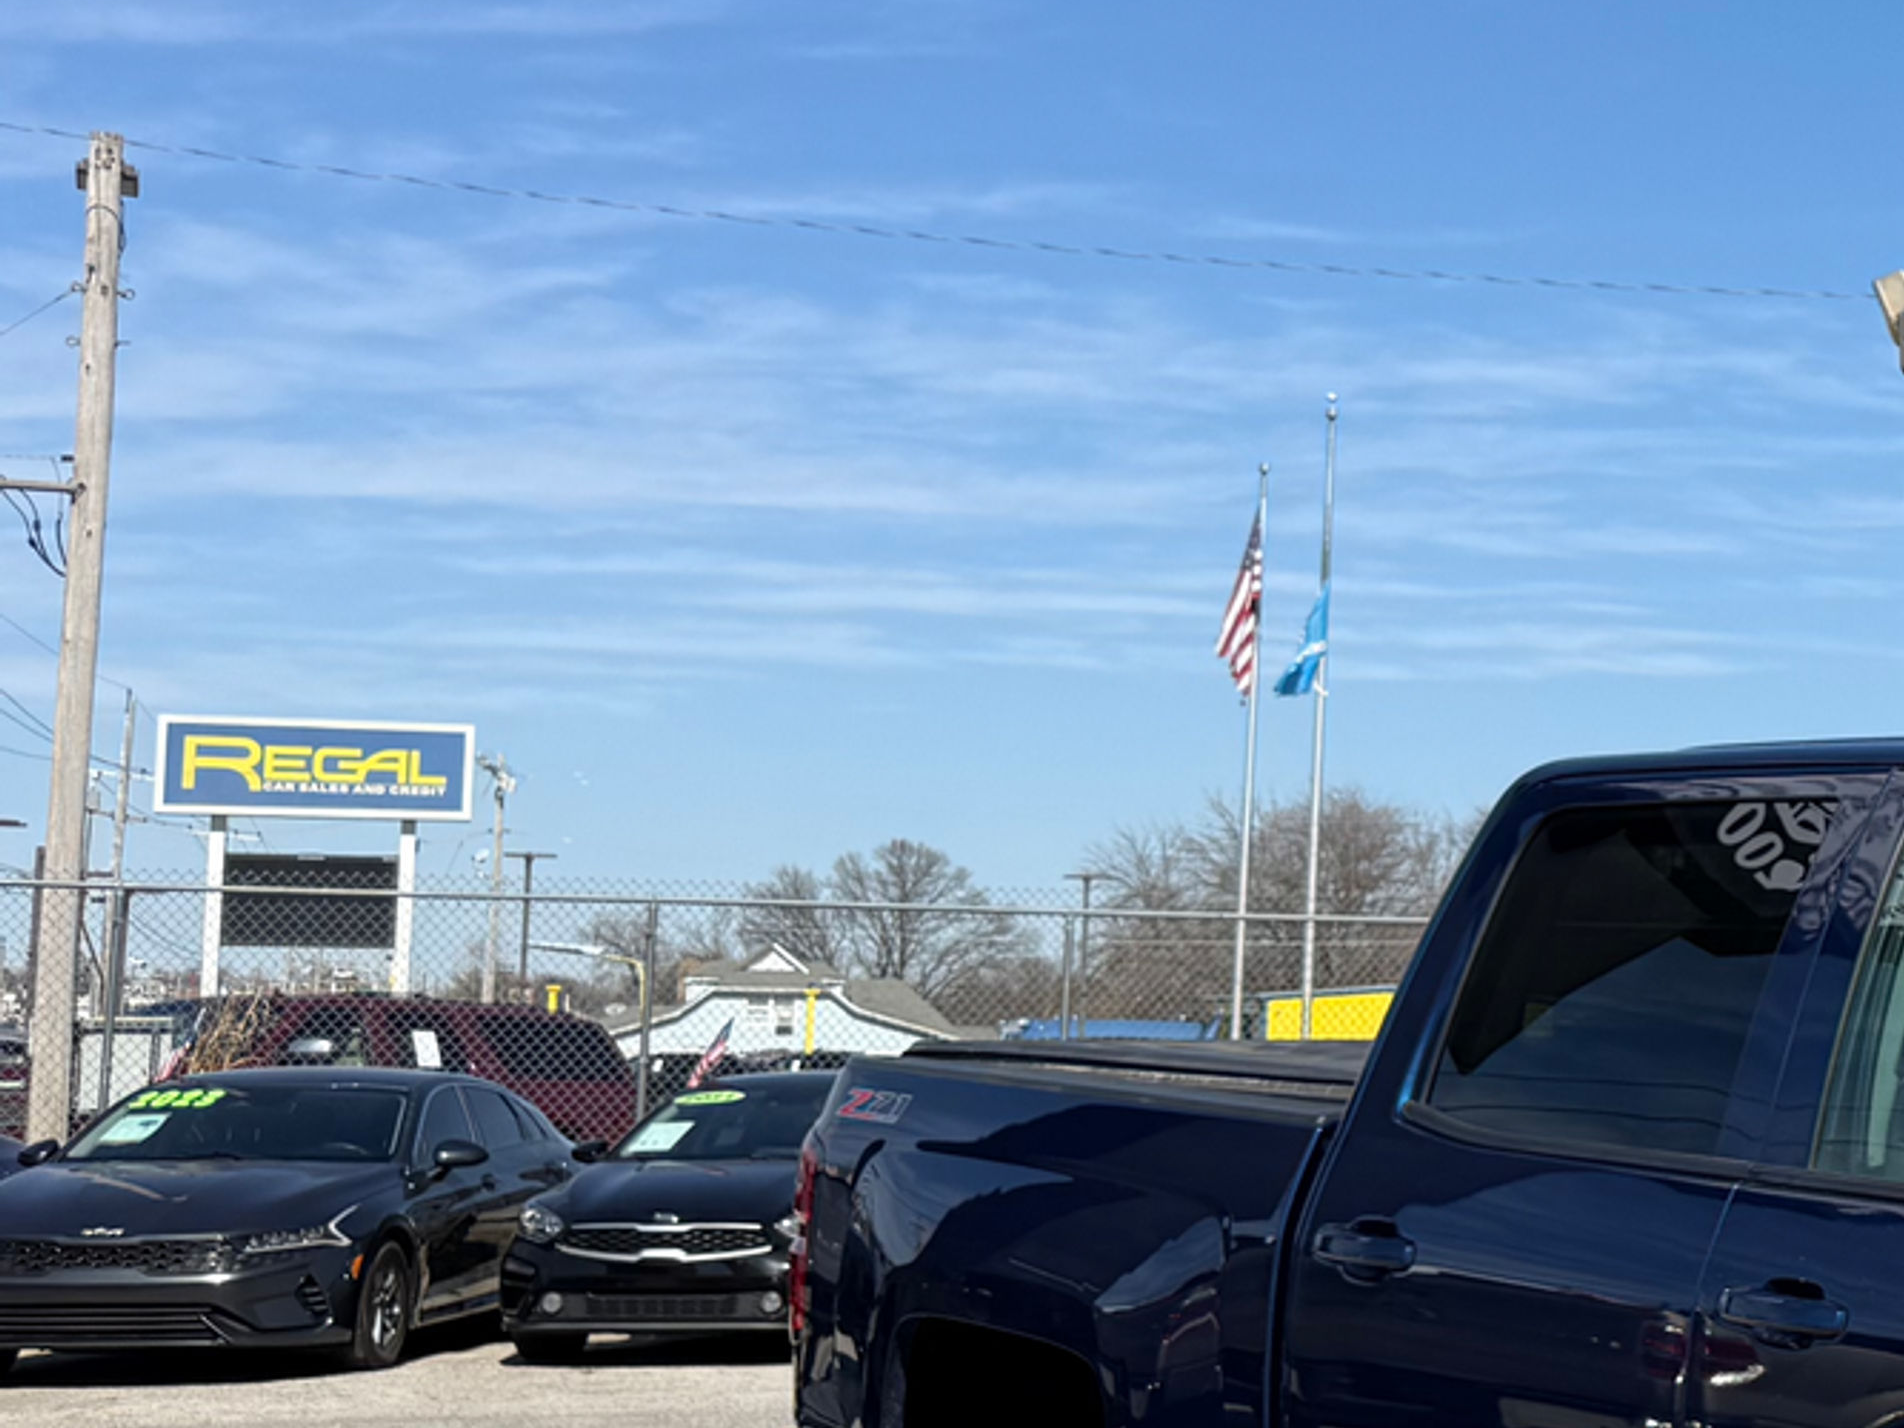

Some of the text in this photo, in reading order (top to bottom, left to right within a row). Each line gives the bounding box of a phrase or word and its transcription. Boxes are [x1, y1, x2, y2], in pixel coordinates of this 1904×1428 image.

[181, 734, 447, 792] REGAL
[263, 782, 446, 797] CAR SALES AND CREDIT
[835, 1086, 913, 1124] Z71
